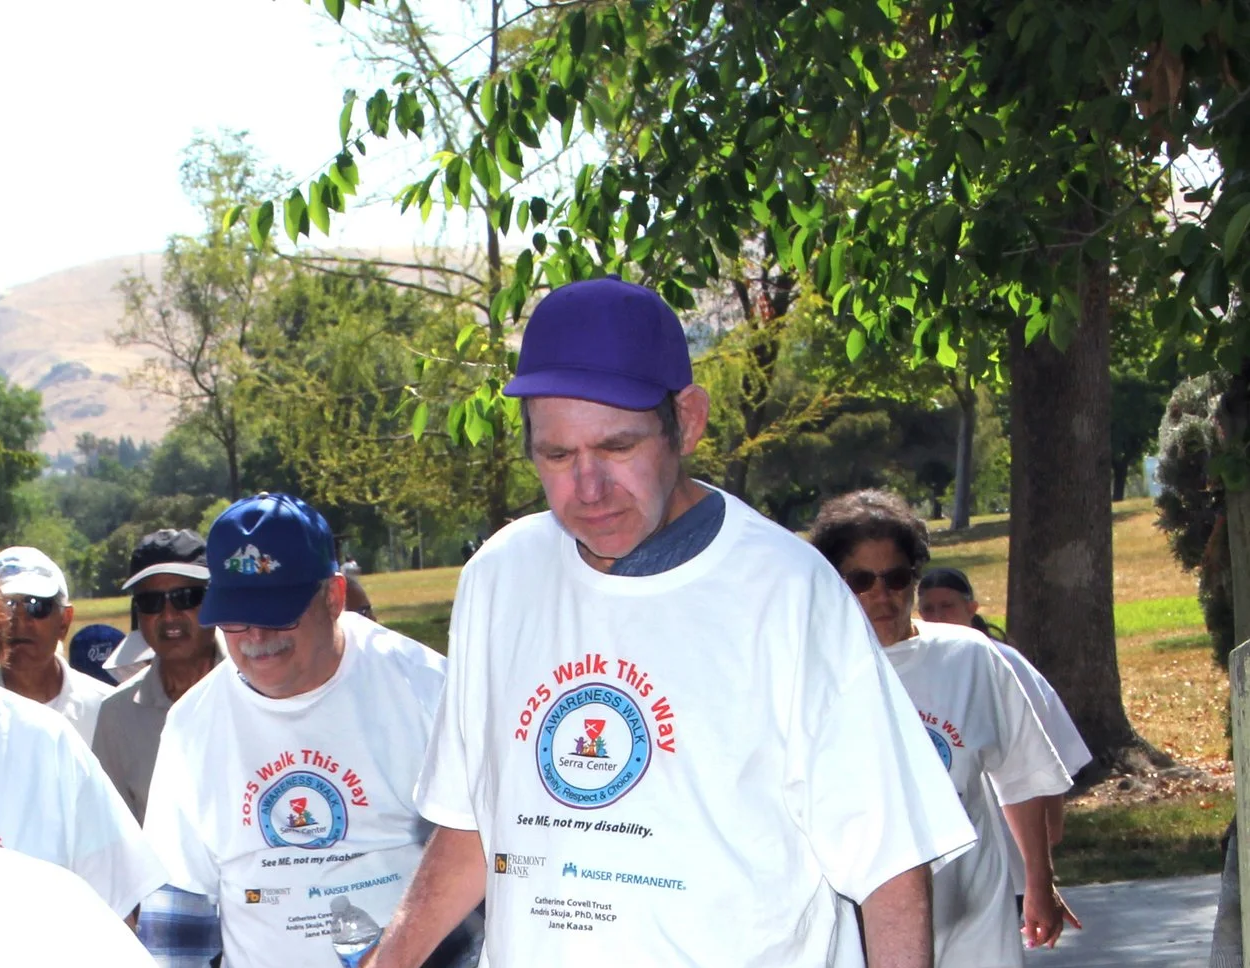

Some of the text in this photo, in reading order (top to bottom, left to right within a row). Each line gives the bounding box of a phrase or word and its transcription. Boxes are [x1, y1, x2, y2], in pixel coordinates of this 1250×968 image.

[515, 653, 676, 753] 2025 Walk This Way
[545, 689, 646, 744] AWARENESS WALK
[918, 710, 939, 725] his
[942, 720, 965, 748] Way
[559, 757, 618, 771] Serra Center
[242, 749, 370, 826] 2025 Walk This Way
[563, 787, 598, 802] Respect
[600, 791, 606, 799] &
[607, 771, 634, 795] Choice
[261, 776, 340, 815] AWARENESS WALK
[517, 814, 654, 838] See ME, not my disability.
[262, 859, 276, 867] See
[311, 857, 324, 865] my
[507, 853, 547, 867] FREMONT
[507, 863, 529, 876] BANK
[581, 868, 612, 882] KAISER
[323, 885, 350, 896] KAISER
[535, 896, 612, 910] Catherine Covell Trust
[550, 909, 572, 918] Skuja,
[595, 913, 617, 922] MSCP
[549, 921, 593, 931] Jane Kaasa
